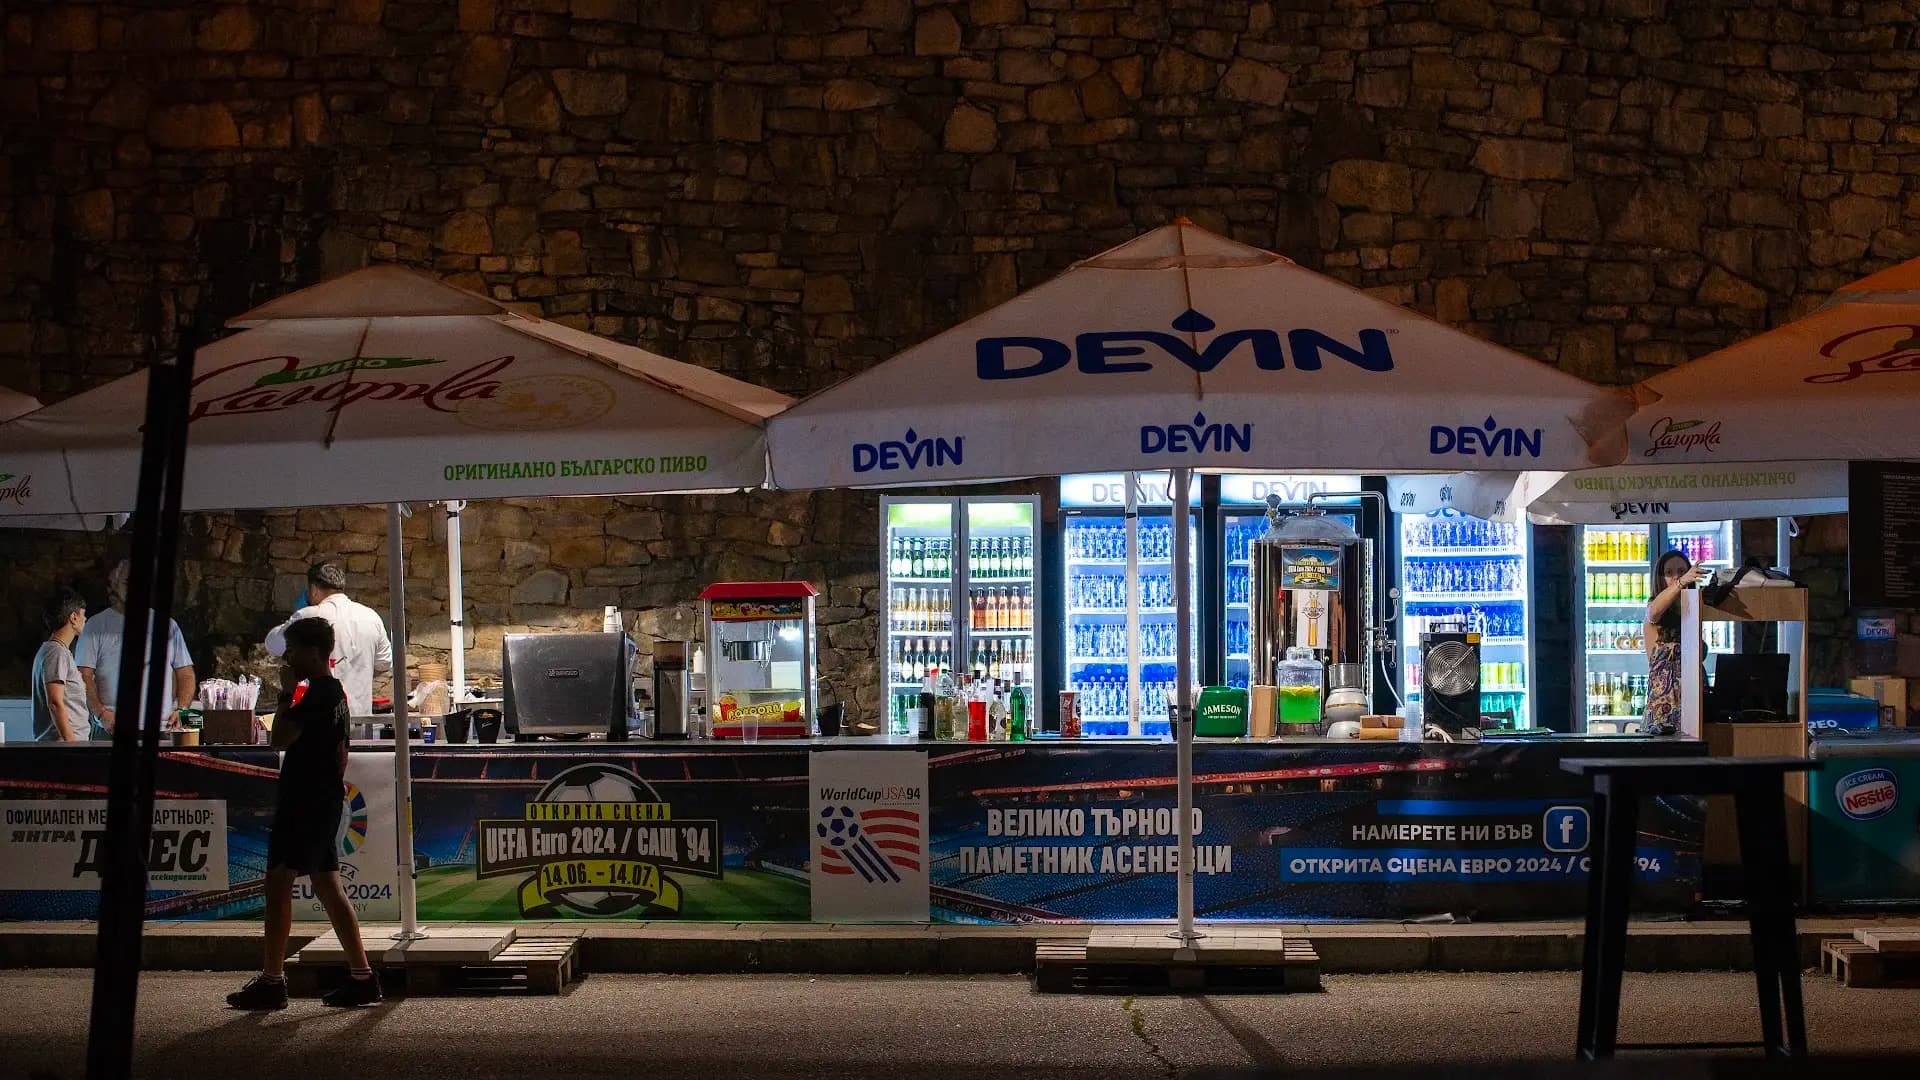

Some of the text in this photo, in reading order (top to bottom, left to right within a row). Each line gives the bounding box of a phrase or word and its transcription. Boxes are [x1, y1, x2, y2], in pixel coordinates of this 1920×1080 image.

[977, 328, 1394, 380] DEVIN
[1141, 423, 1251, 453] DEVIN
[1430, 425, 1541, 458] DEVIN
[853, 436, 963, 472] DEVIN
[444, 455, 707, 481] ОРИГИНАЛНО БЪЛГАРСКО ПИВО
[1202, 704, 1242, 716] JAMESON
[1808, 719, 1839, 729] REO
[1858, 771, 1885, 784] CREAM
[6, 809, 85, 827] ОФИЦИАЛЕН
[151, 809, 214, 825] АРТНЬОР:
[530, 803, 665, 821] ОТКРИТА СЦЕНА
[987, 808, 1084, 837] ВЕЛИКО
[11, 830, 76, 843] ЯНТРА
[486, 826, 528, 863] UEFA
[532, 827, 568, 856] Euro
[571, 826, 617, 856] 2024
[637, 826, 678, 862] САЩ
[1352, 823, 1534, 841] НАМЕРЕТЕ НИ ВЪВ
[73, 830, 210, 877] ДЕС
[959, 845, 1232, 876] ПАМЕТНИК АСЕНЕЦИ
[543, 863, 591, 887] 14.06.
[609, 862, 654, 888] 14.07.
[1289, 857, 1383, 875] ОТКРИТА
[1387, 857, 1457, 877] СЦЕНА
[1460, 858, 1512, 875] ЕВРО
[1516, 857, 1561, 874] 2024
